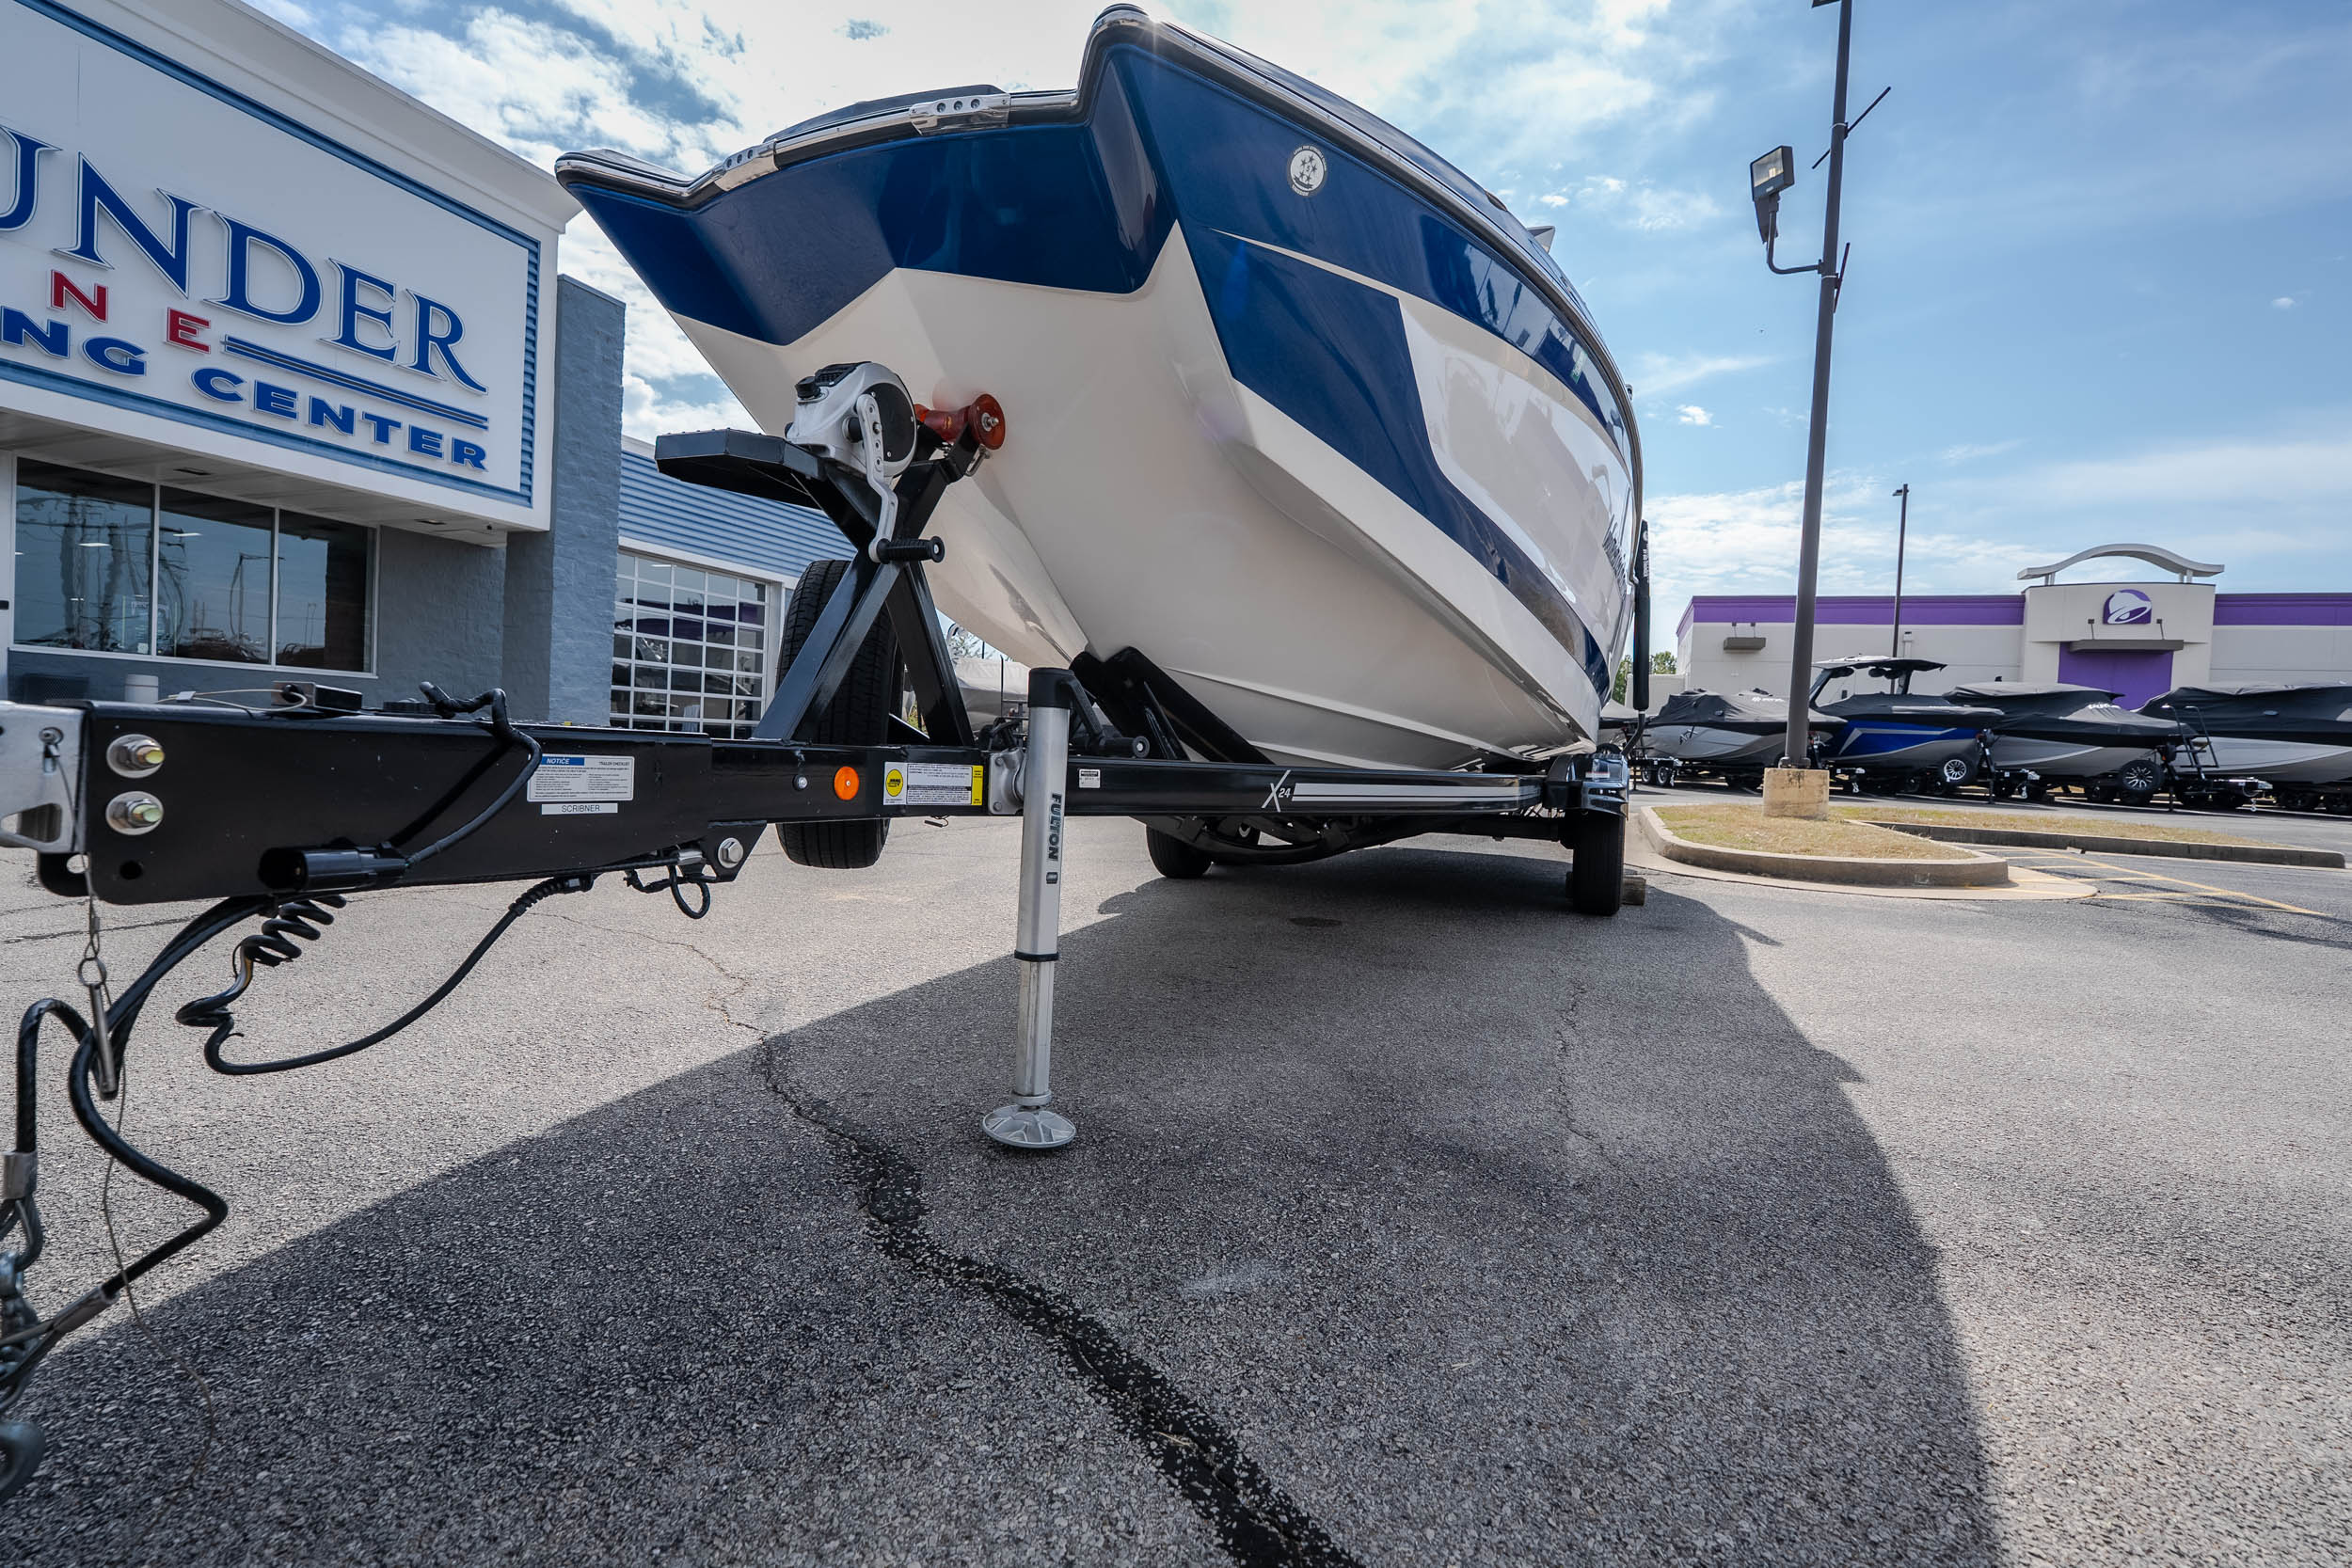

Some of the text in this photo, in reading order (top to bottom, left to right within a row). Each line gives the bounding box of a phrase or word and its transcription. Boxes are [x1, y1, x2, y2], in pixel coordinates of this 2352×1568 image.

[191, 367, 488, 471] CENTER
[561, 804, 600, 813] SCRIBNER
[1048, 793, 1062, 862] FULTON
